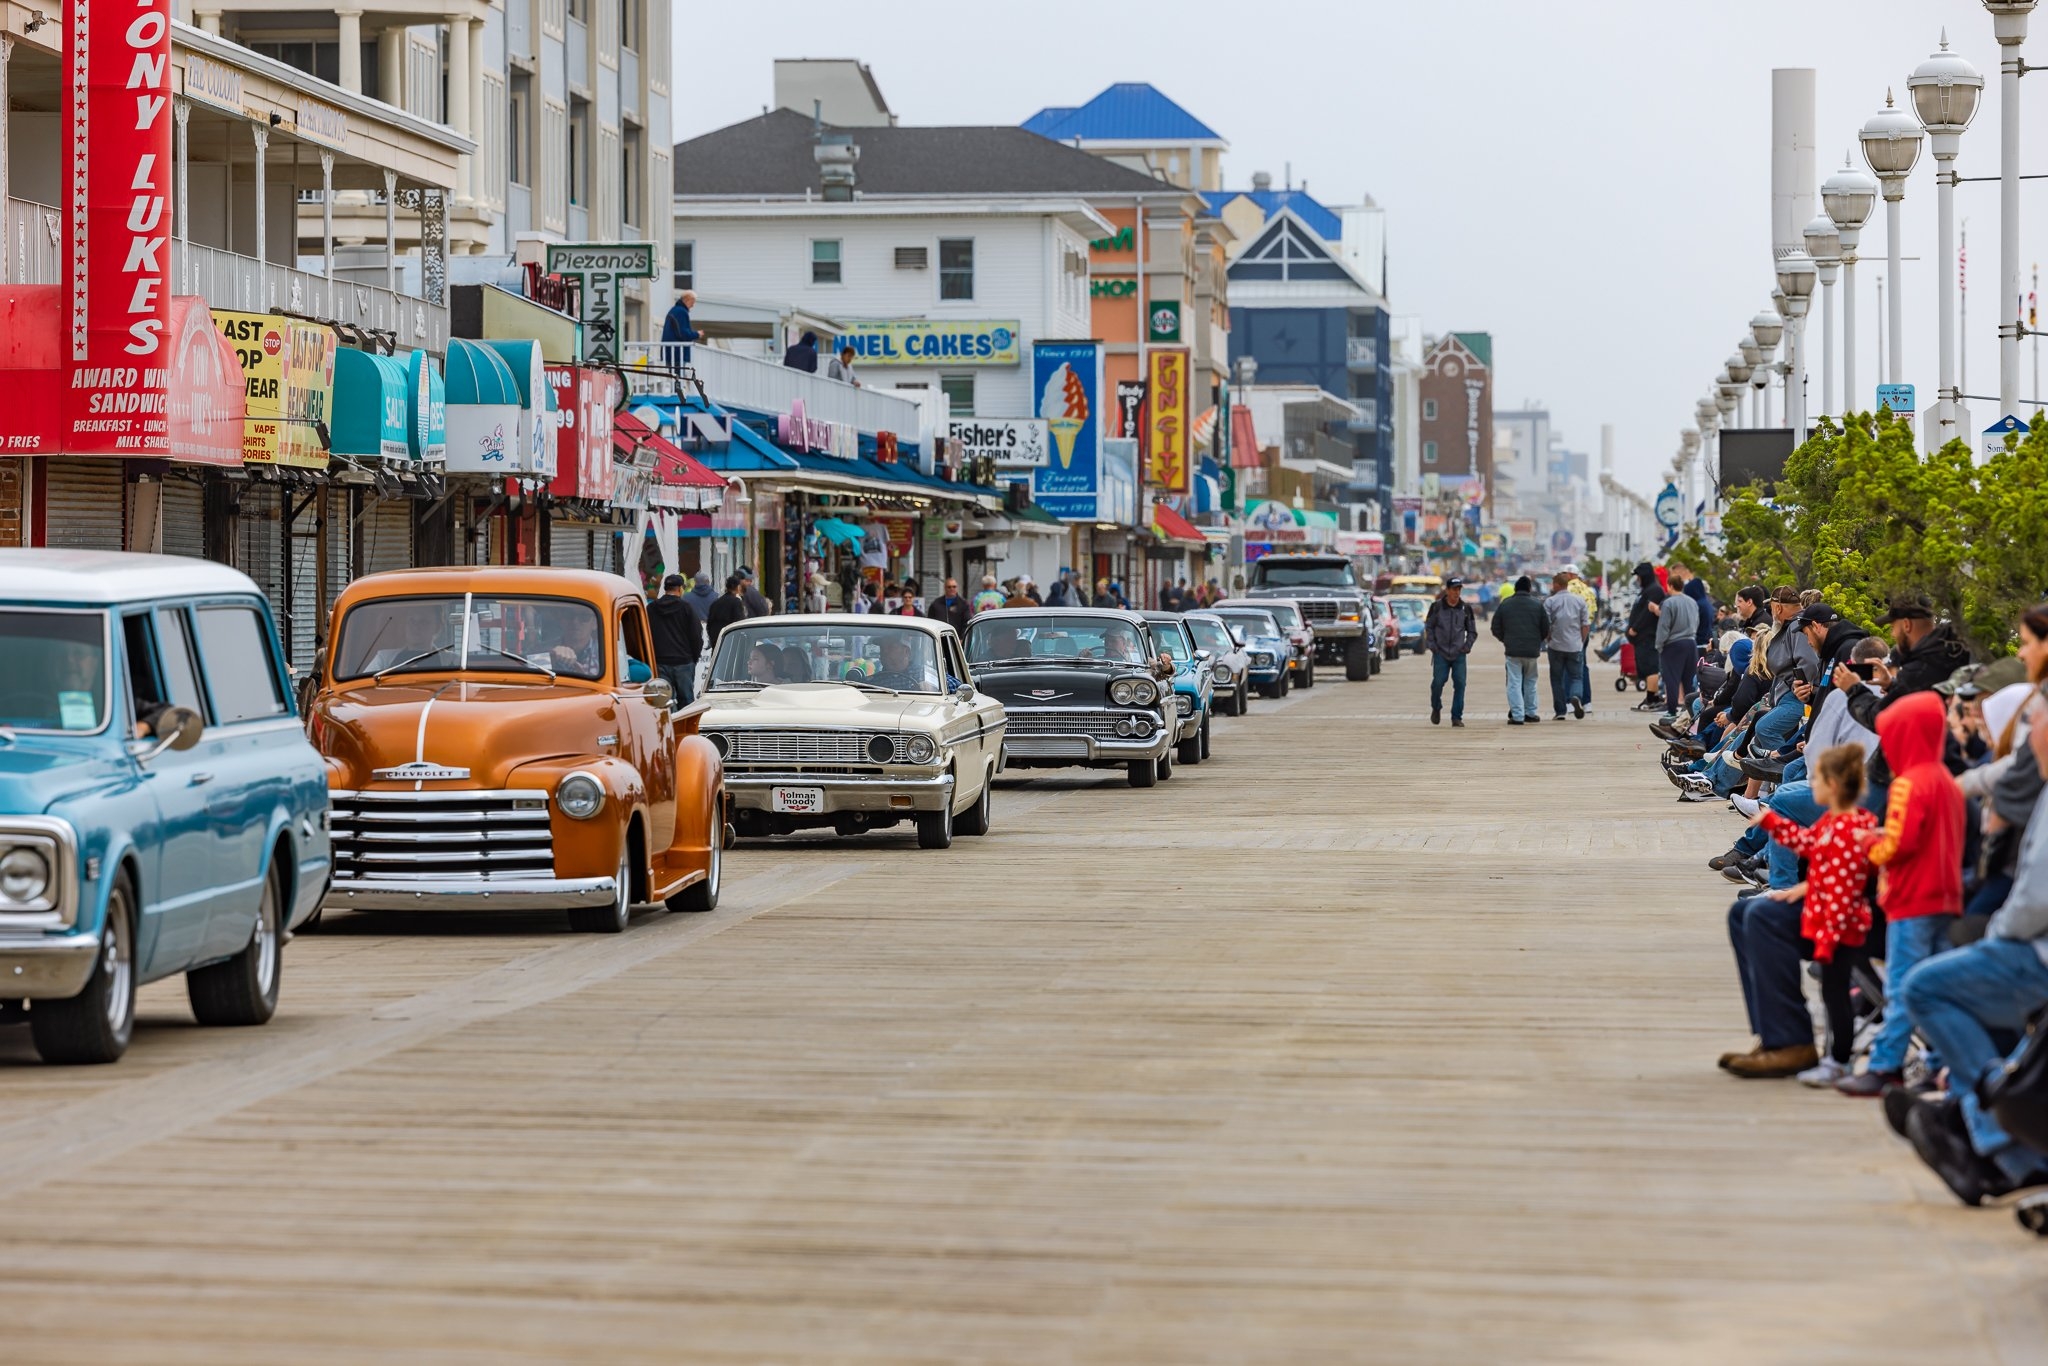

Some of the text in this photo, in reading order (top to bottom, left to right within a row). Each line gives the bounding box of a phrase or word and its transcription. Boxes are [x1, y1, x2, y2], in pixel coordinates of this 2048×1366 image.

[121, 0, 167, 355] ONY LUKES
[552, 252, 647, 270] Piezano's
[589, 272, 614, 363] PIZZA
[264, 338, 281, 348] STOP
[905, 333, 994, 358] CAKES
[235, 349, 263, 370] OP
[71, 368, 138, 389] AWARD
[1157, 355, 1178, 413] FUN
[73, 420, 166, 433] BREAKFAST LUNCH
[254, 424, 276, 434] VAPE
[7, 435, 41, 448] FRIES
[115, 435, 143, 448] MILK
[949, 422, 1016, 447] Fisher's
[962, 449, 1011, 460] OP CORN
[1156, 415, 1179, 487] CITY
[386, 770, 454, 778] CHEVROLET
[780, 790, 816, 799] holman
[783, 798, 816, 806] moody
